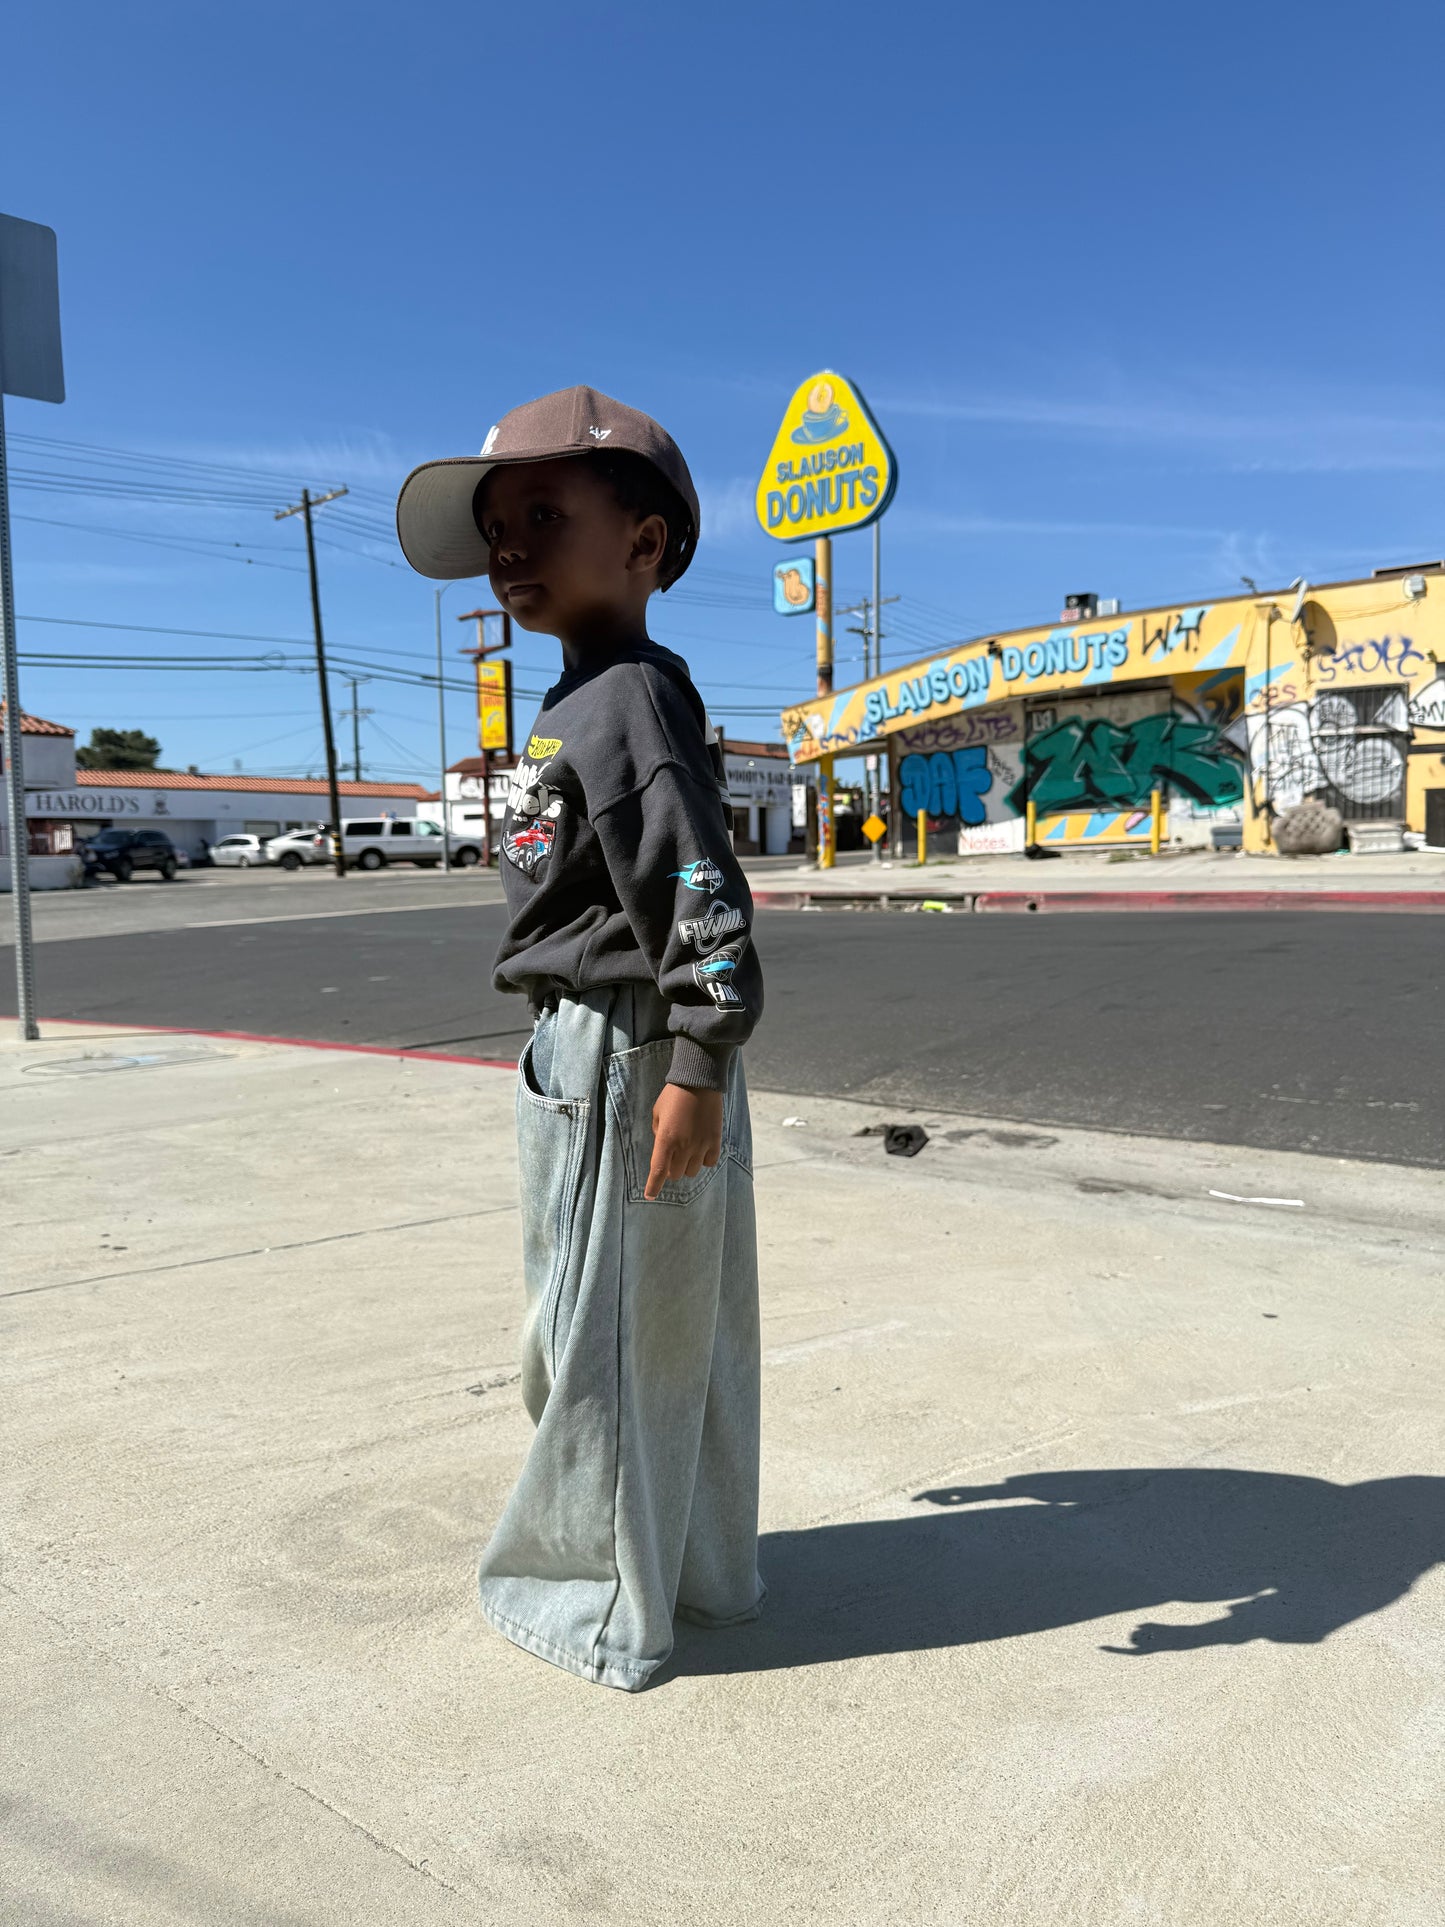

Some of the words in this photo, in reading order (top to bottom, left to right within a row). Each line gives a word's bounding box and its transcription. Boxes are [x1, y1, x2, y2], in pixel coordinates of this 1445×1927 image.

[775, 441, 865, 485] SLAUSON
[766, 465, 880, 529] DONUTS
[864, 654, 992, 725] SLAUSON
[1002, 630, 1129, 682] DONUTS
[35, 793, 141, 814] HAROLD'S
